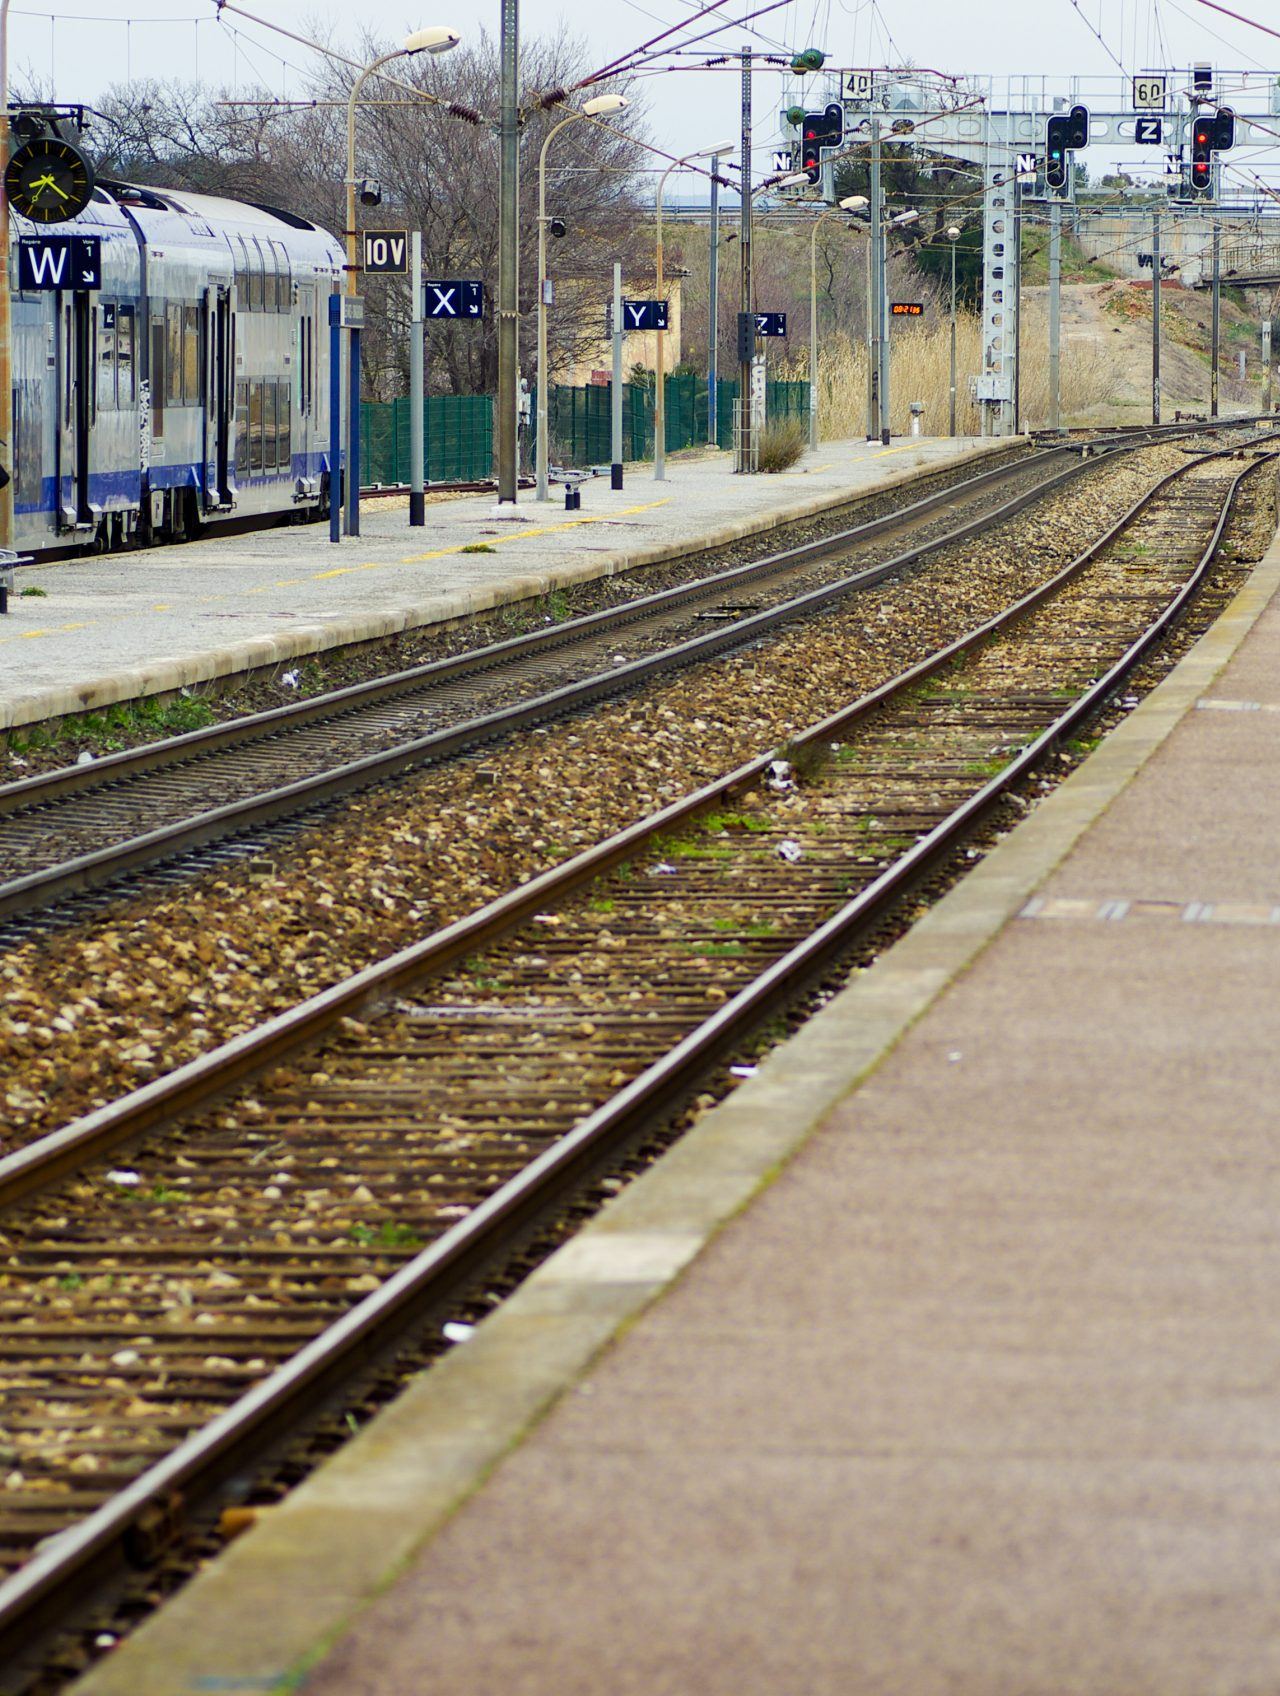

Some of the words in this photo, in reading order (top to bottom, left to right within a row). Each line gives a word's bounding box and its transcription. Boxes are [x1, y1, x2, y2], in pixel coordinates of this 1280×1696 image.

[847, 75, 868, 93] 40
[1138, 84, 1160, 101] 60
[1141, 121, 1158, 140] Z
[27, 247, 67, 285] W
[86, 246, 92, 257] 1
[432, 288, 457, 315] X
[472, 288, 477, 296] 1
[628, 305, 647, 327] Y
